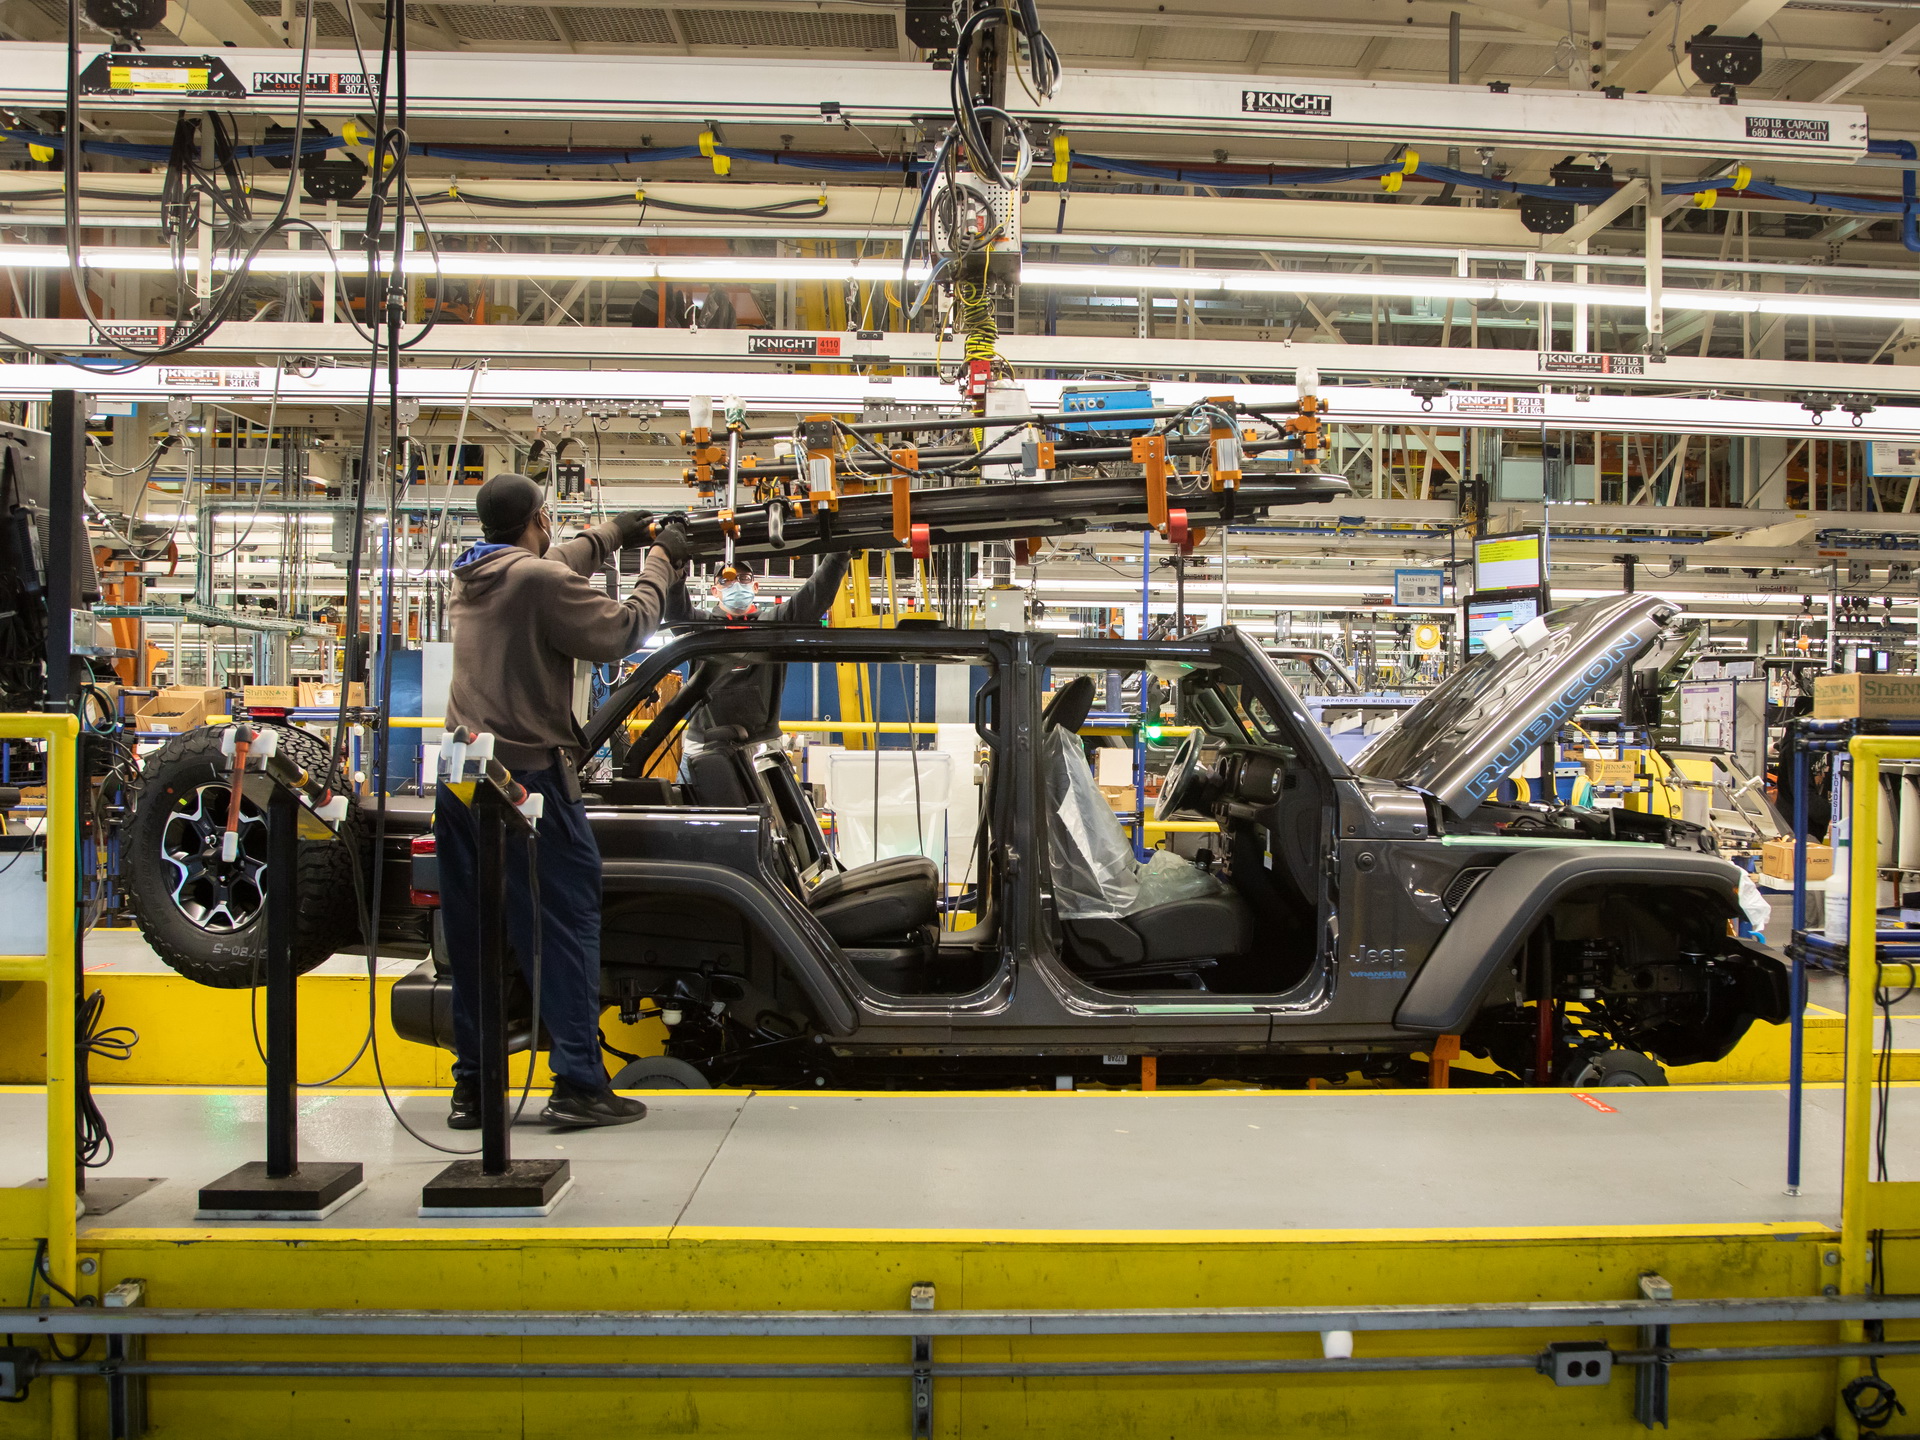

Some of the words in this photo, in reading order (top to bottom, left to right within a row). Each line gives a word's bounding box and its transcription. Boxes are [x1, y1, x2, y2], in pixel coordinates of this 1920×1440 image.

[340, 74, 360, 84] 2000
[346, 85, 360, 94] 907
[1259, 93, 1330, 110] KNIGHT
[1750, 118, 1769, 128] 1500
[1772, 120, 1784, 128] LB.
[1786, 120, 1827, 130] CAPACITY
[1752, 128, 1768, 137] 680
[1772, 129, 1786, 138] KG.
[1788, 130, 1827, 140] CAPACITY
[102, 327, 157, 336] KNIGHT
[757, 339, 815, 348] KNIGHT
[1549, 355, 1601, 363] KNIGHT
[1464, 630, 1642, 800] RUBICON
[1350, 945, 1407, 968] Jeep
